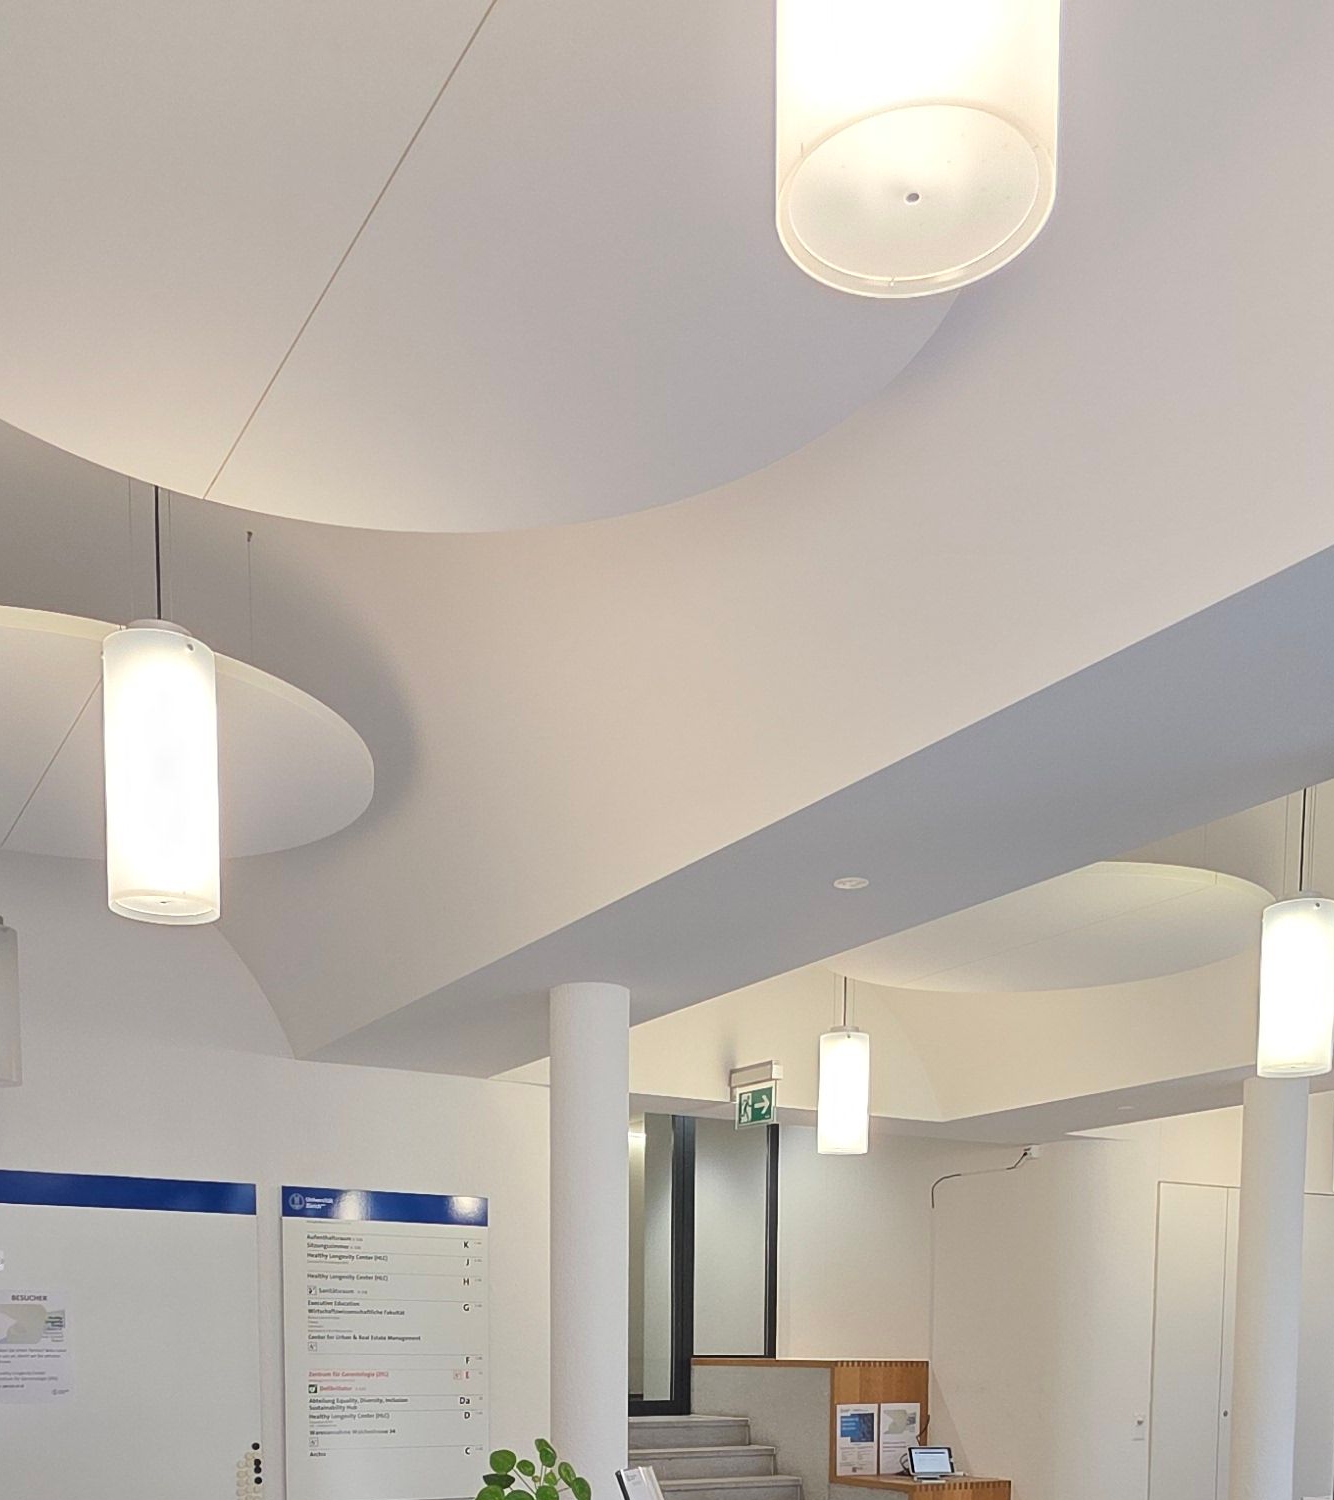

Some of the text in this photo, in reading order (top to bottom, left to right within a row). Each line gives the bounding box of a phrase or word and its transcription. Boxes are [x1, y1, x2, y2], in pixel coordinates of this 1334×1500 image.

[463, 1241, 469, 1249] K
[463, 1278, 470, 1286] H
[463, 1303, 469, 1312] G
[465, 1447, 470, 1455] C
